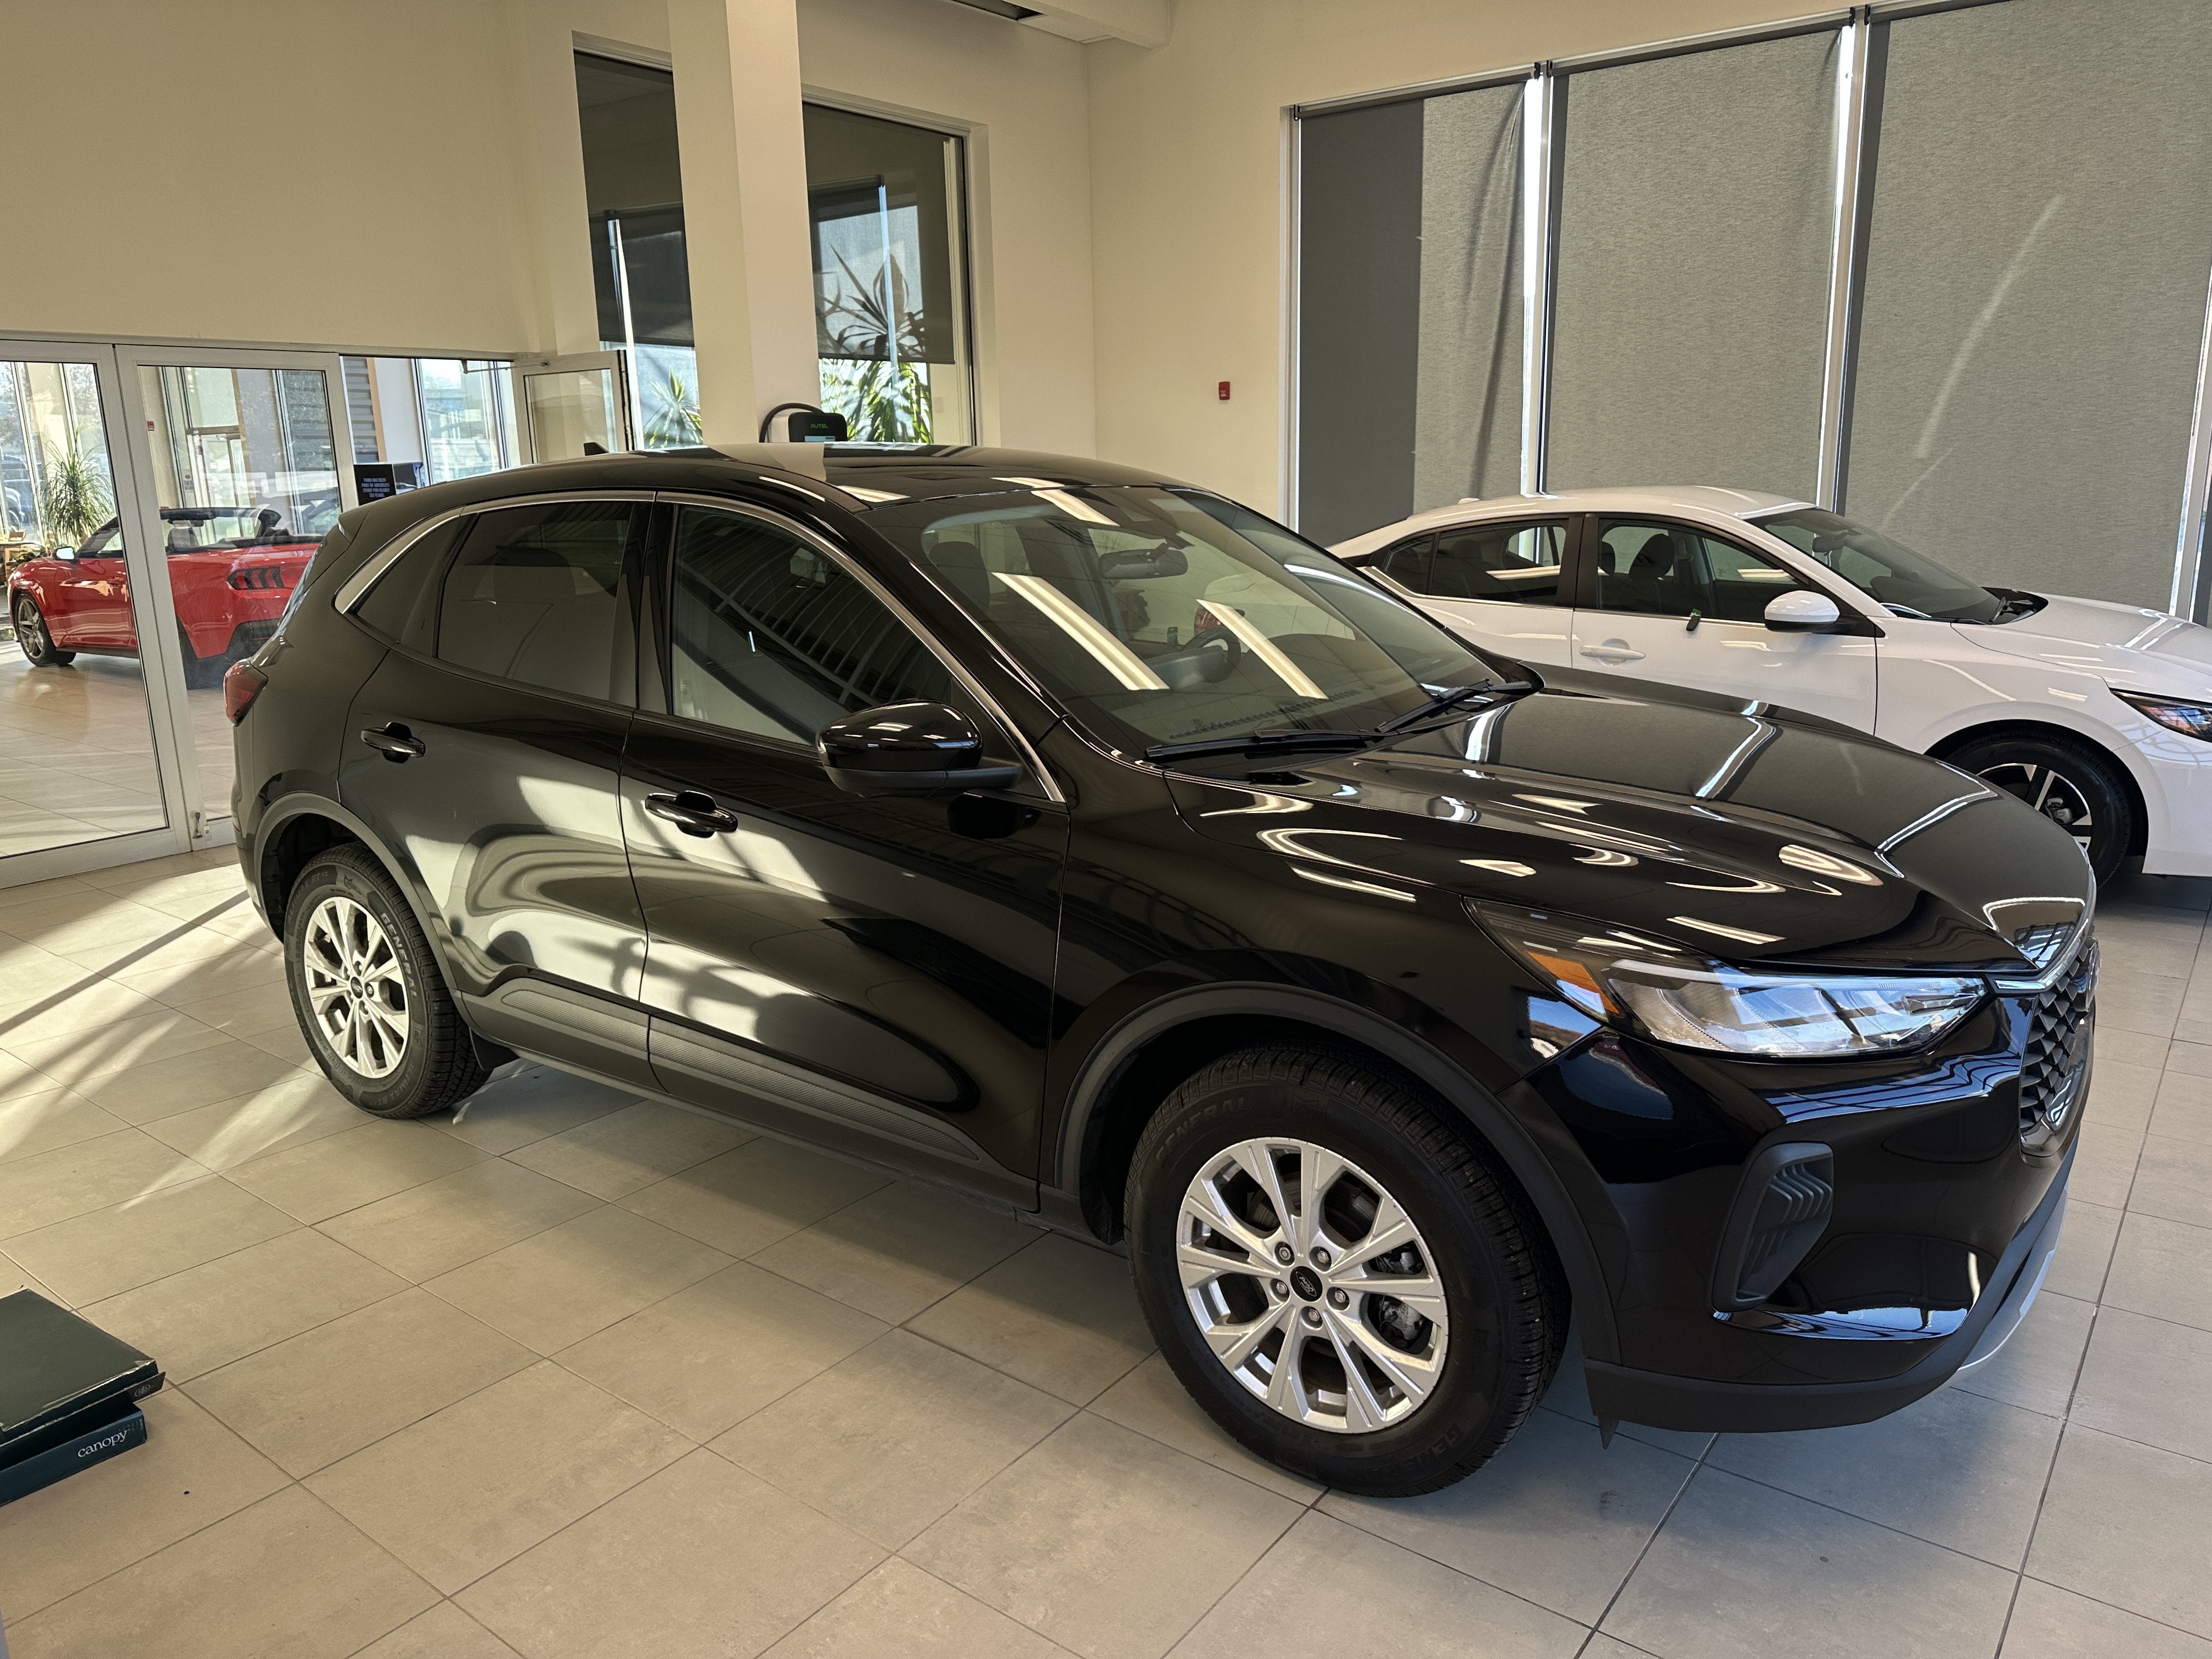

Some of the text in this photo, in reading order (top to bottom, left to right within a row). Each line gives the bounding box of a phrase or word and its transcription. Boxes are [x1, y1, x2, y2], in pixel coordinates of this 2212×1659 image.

[380, 912, 417, 1001] GENERAL
[1155, 1097, 1253, 1161] GENERAL
[77, 1430, 128, 1458] canopy
